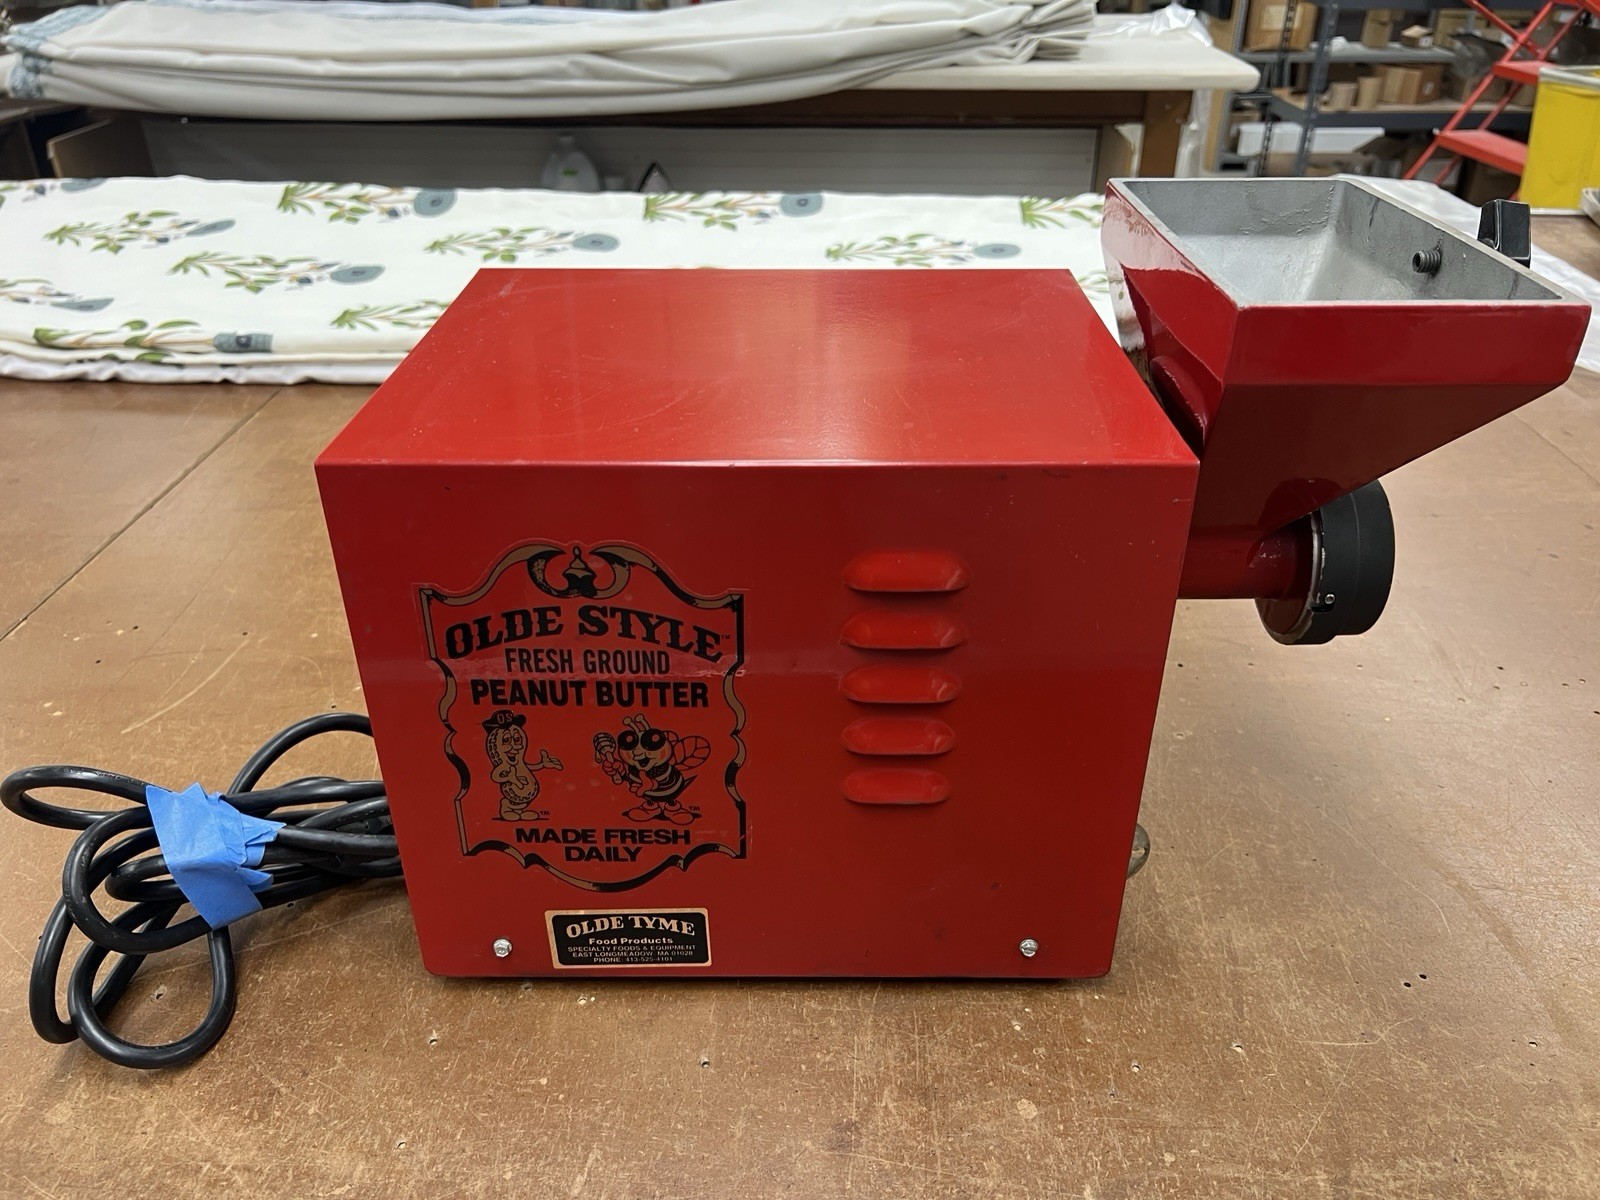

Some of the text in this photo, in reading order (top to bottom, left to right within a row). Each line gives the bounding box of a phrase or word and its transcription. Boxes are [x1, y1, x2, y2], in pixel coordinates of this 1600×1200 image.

[445, 605, 564, 659] OLDE
[578, 604, 724, 663] STYLE
[504, 648, 670, 675] FRESH GROUND
[470, 679, 709, 708] PEANUT BUTTER
[515, 828, 691, 845] MADE FRESH
[565, 846, 643, 862] DAILY
[566, 915, 695, 938] OLDE TYME
[621, 937, 674, 945] Products
